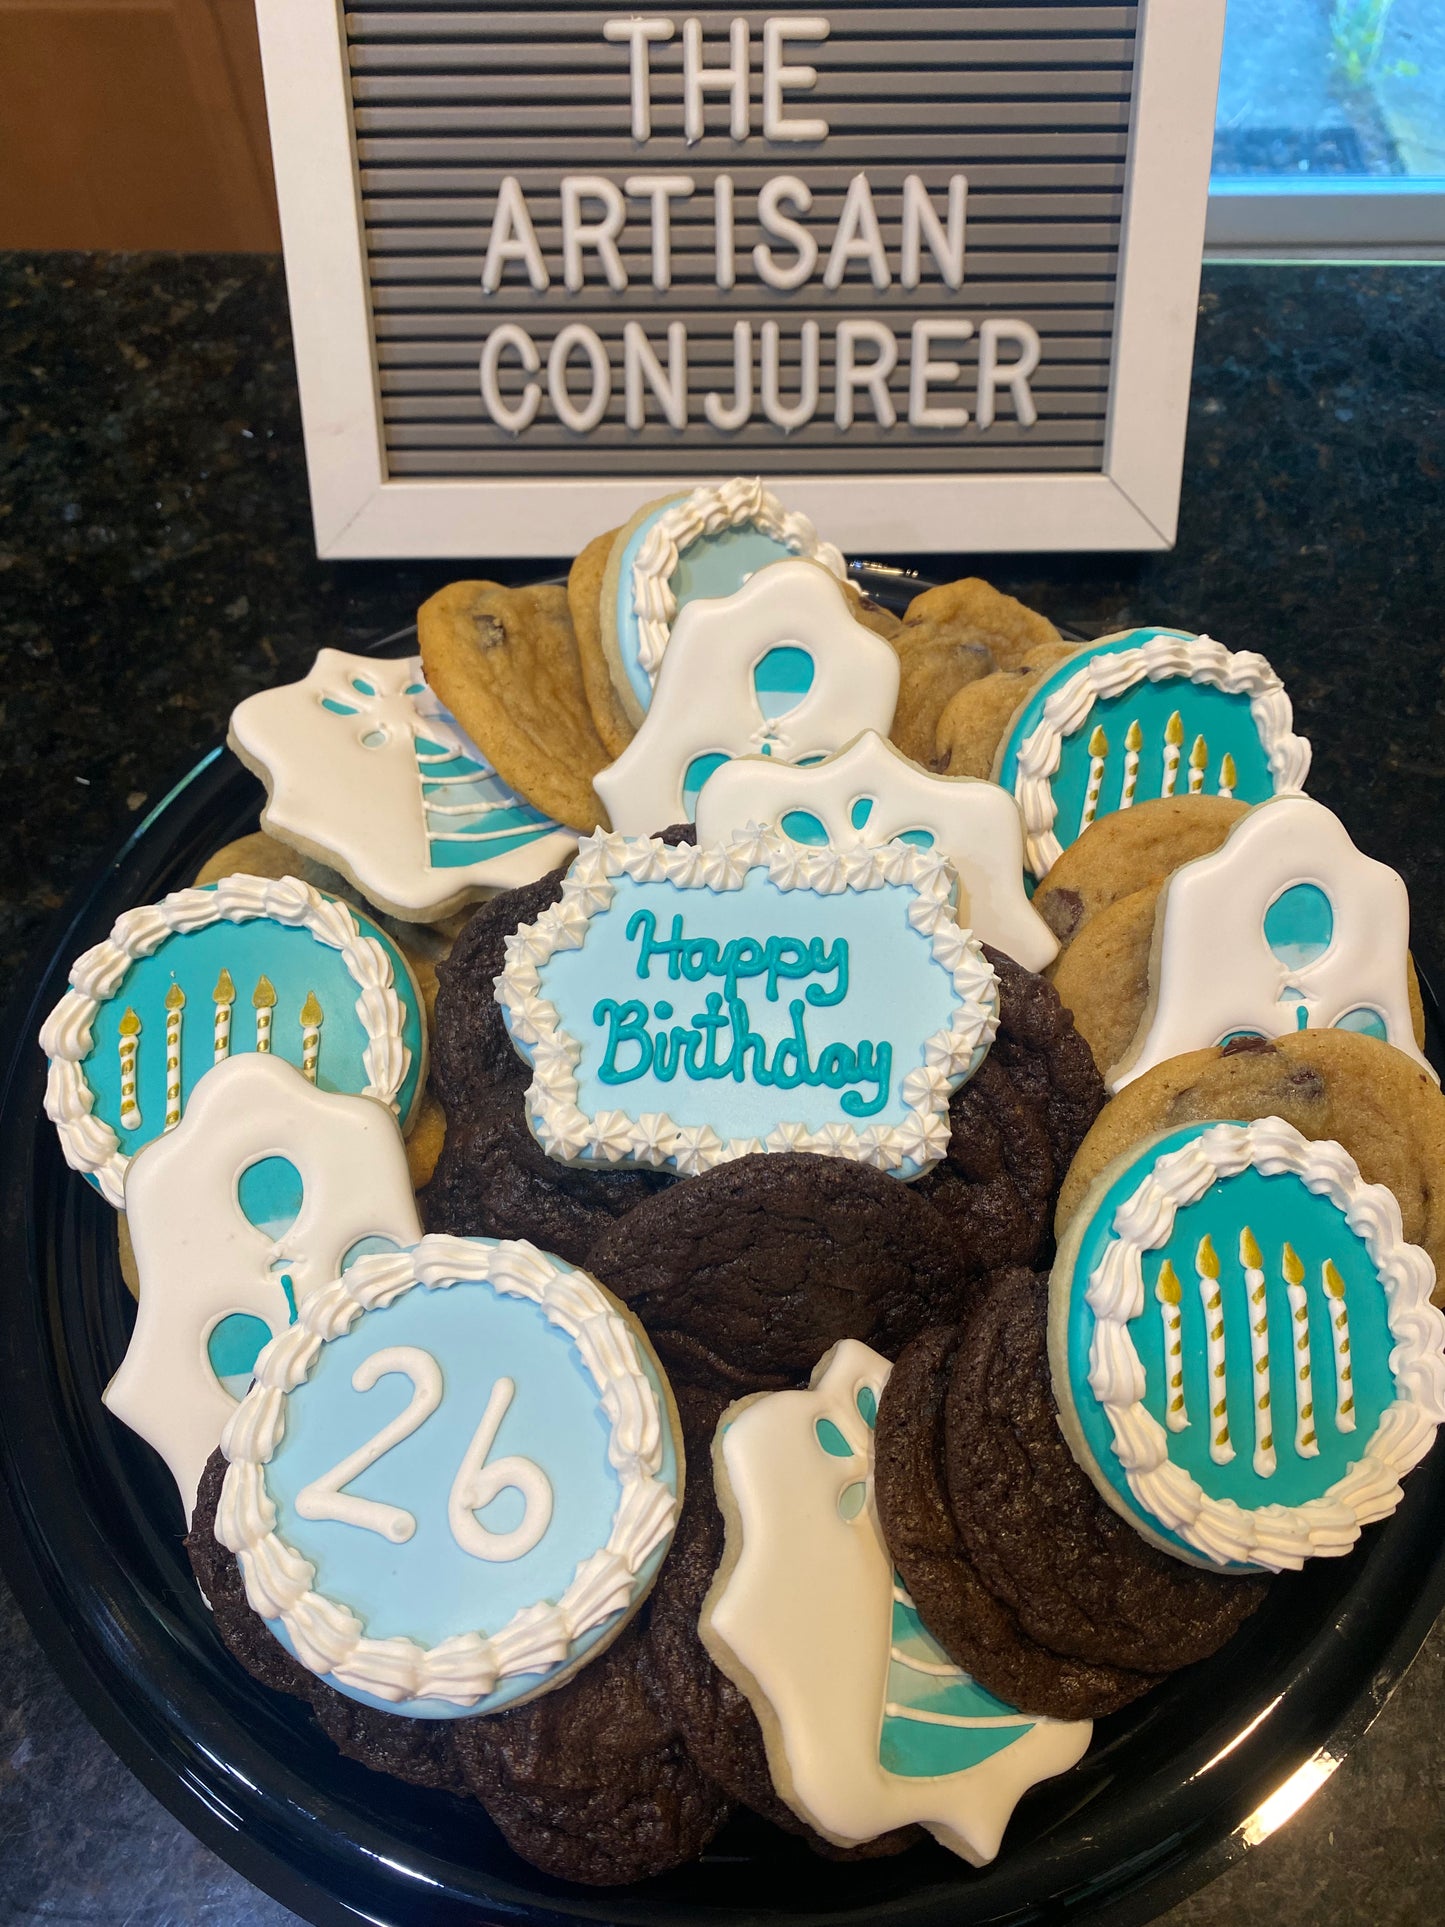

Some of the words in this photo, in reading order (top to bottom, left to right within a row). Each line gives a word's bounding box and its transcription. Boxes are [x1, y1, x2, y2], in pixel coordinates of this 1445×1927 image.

[602, 17, 831, 145] THE
[481, 173, 969, 294] ARTISAN
[479, 319, 1041, 434] CONJURER
[626, 909, 849, 1006] Happy
[593, 992, 892, 1117] Birthday
[296, 1347, 554, 1561] 26
